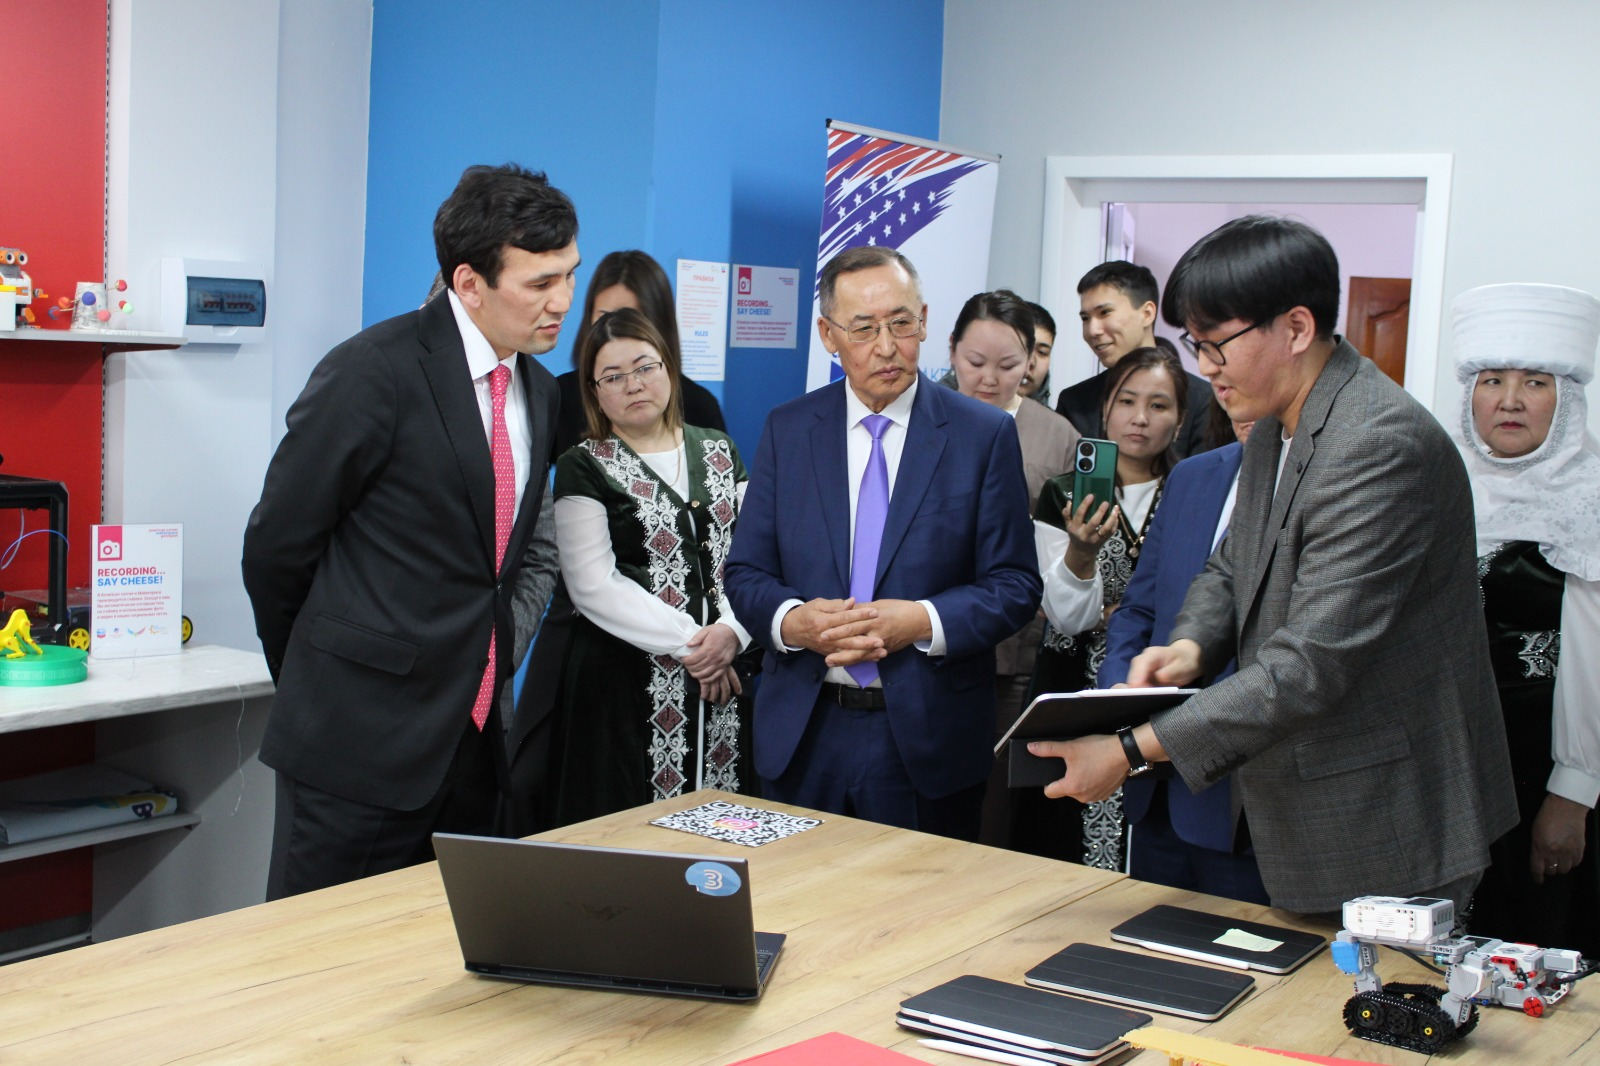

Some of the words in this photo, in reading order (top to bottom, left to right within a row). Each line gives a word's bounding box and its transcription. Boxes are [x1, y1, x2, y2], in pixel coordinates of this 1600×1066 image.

[737, 299, 774, 308] RECORDING...
[737, 307, 748, 315] SAY
[749, 307, 772, 316] CHEESE!
[97, 567, 166, 577] RECORDING...
[97, 577, 118, 587] SAY
[120, 575, 163, 586] CHEESE!
[703, 869, 723, 890] 3
